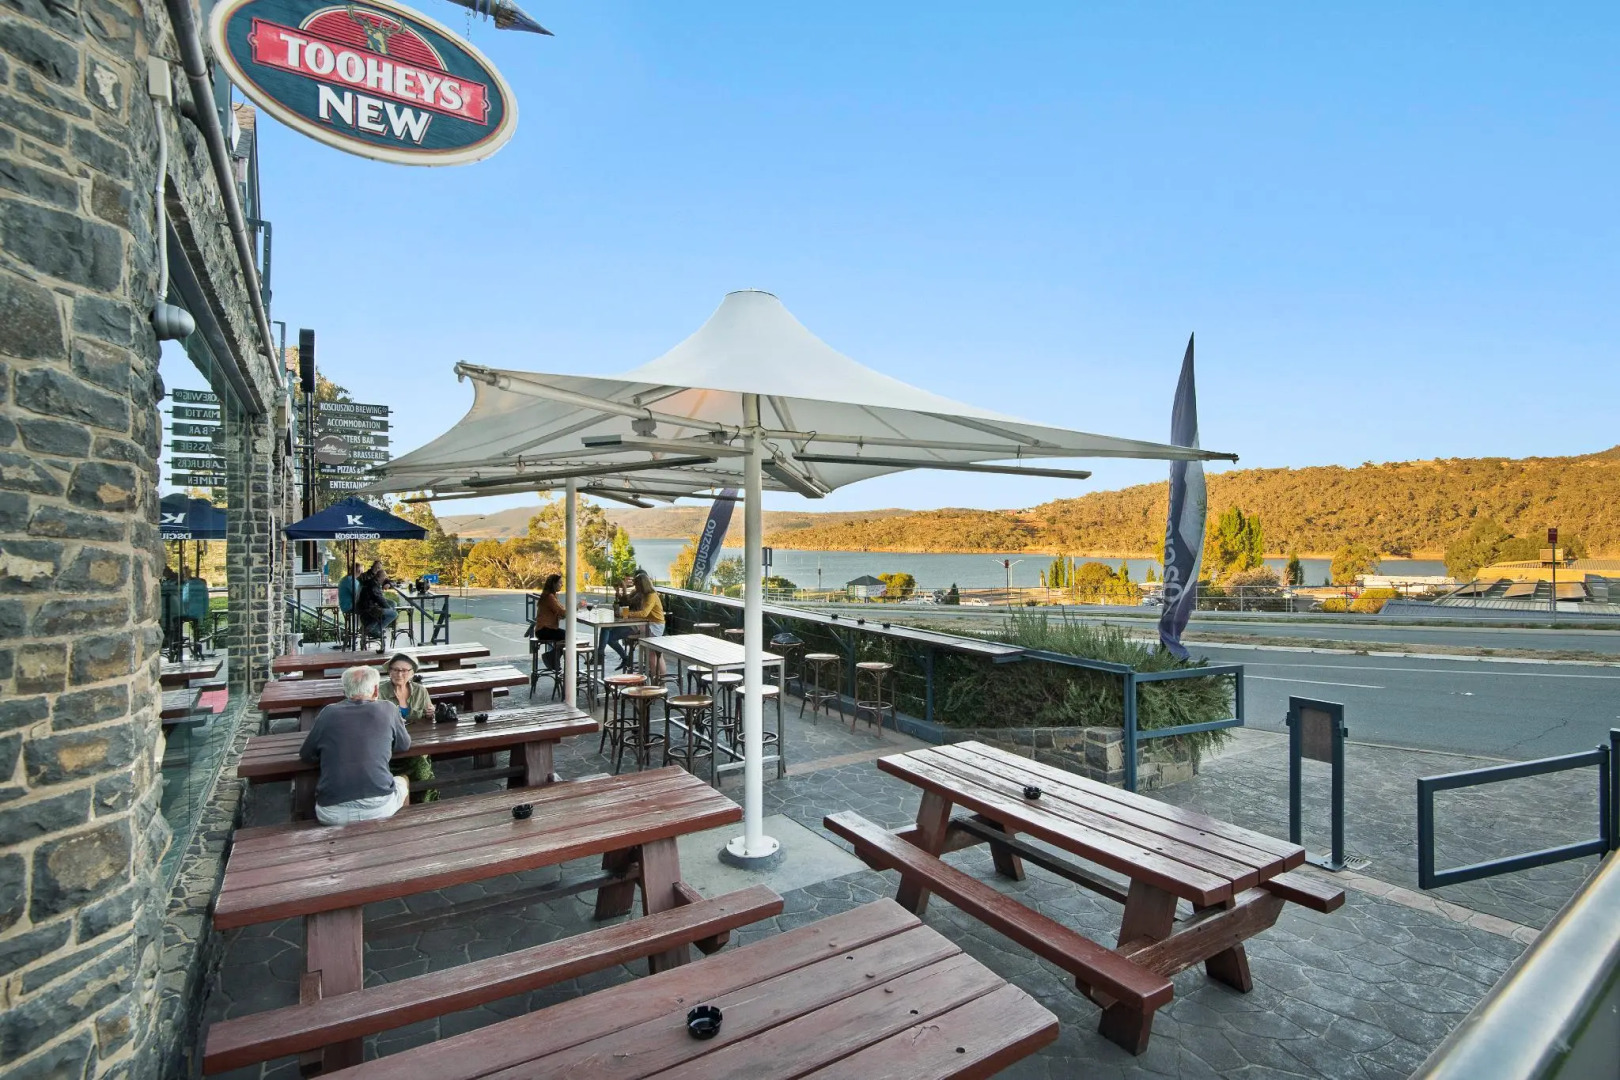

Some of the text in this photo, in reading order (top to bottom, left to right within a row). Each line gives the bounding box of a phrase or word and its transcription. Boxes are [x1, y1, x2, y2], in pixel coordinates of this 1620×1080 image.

[279, 33, 464, 110] TOOHEYS
[316, 83, 432, 145] NEW
[320, 402, 355, 412] KOSCIUSZKO
[355, 405, 382, 414] BREWING
[327, 418, 380, 429] ACCOMMODATION
[362, 437, 375, 445] BAR
[353, 450, 385, 460] BRASSERIE
[337, 465, 356, 474] PIZZAS
[346, 514, 364, 525] K
[335, 532, 381, 540] KOSCIUSZKO
